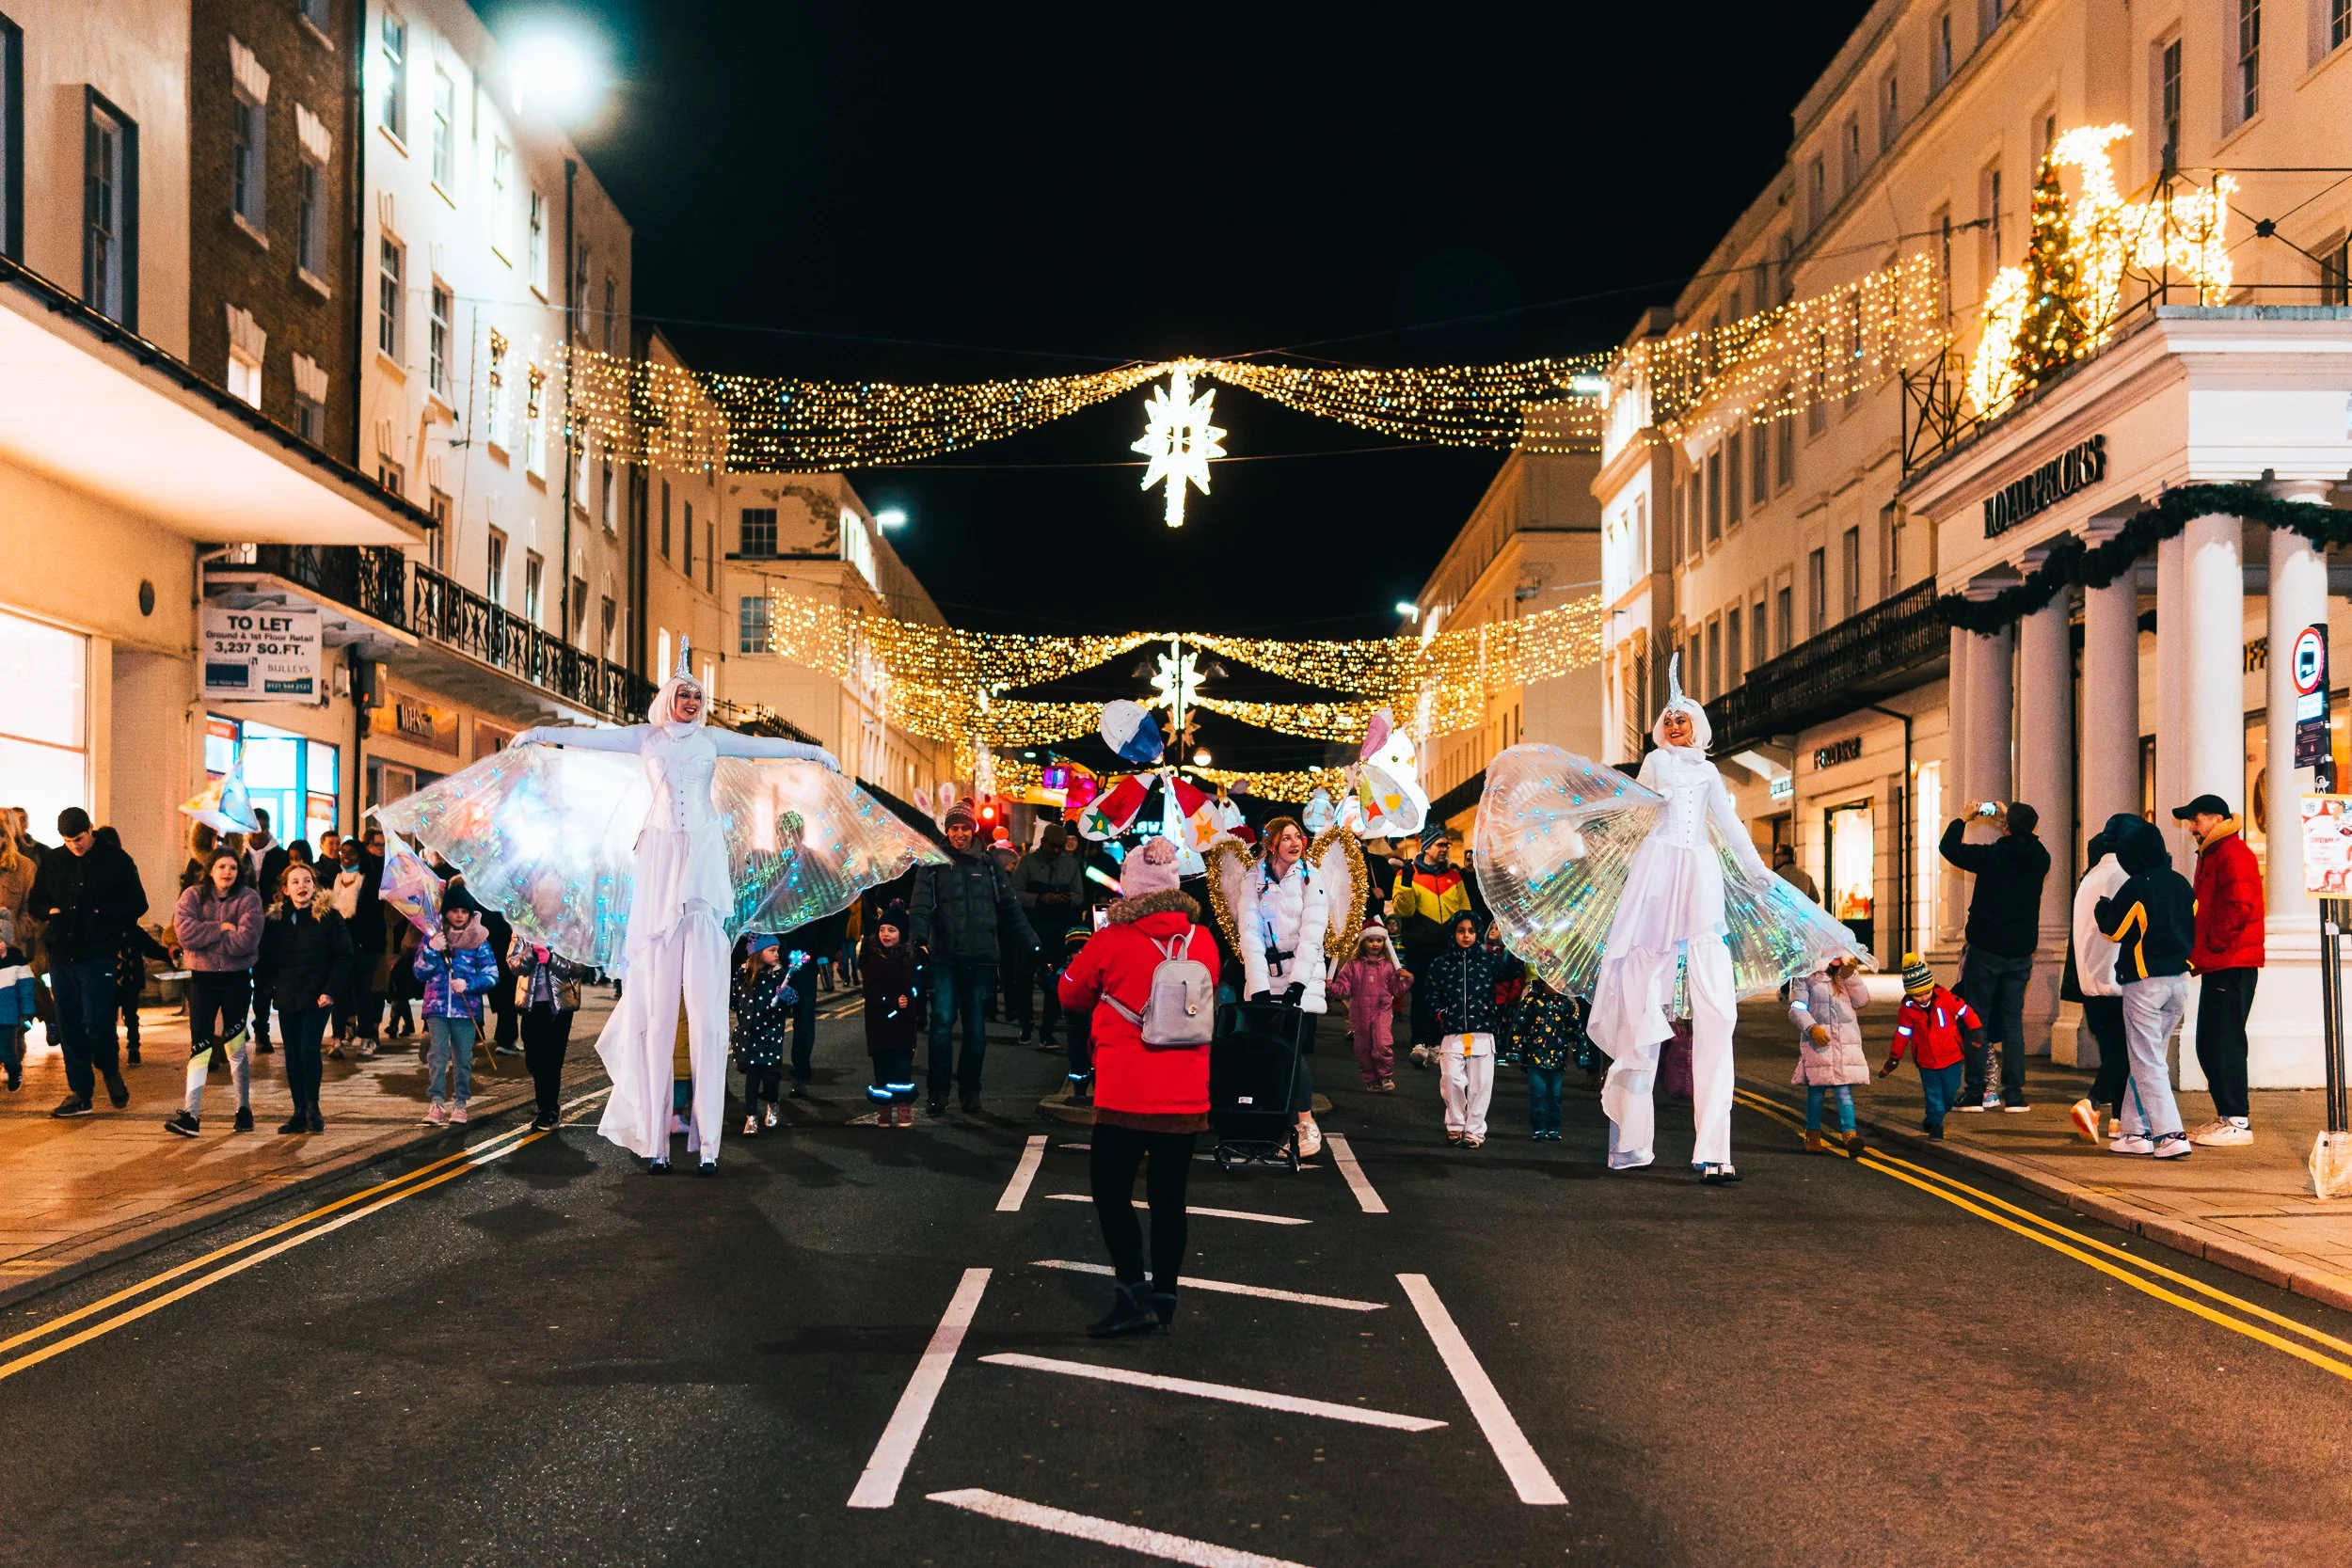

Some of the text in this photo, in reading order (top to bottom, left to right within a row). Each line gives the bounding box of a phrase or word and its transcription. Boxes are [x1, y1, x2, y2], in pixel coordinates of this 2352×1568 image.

[1983, 434, 2106, 539] ROYAL PRIORS
[228, 615, 293, 632] TO LET
[205, 630, 238, 640] Ground
[264, 633, 286, 641] Floor
[289, 634, 314, 642] Retail
[215, 641, 305, 656] 3,237 SQ.FT.
[267, 663, 310, 673] BULLEYS
